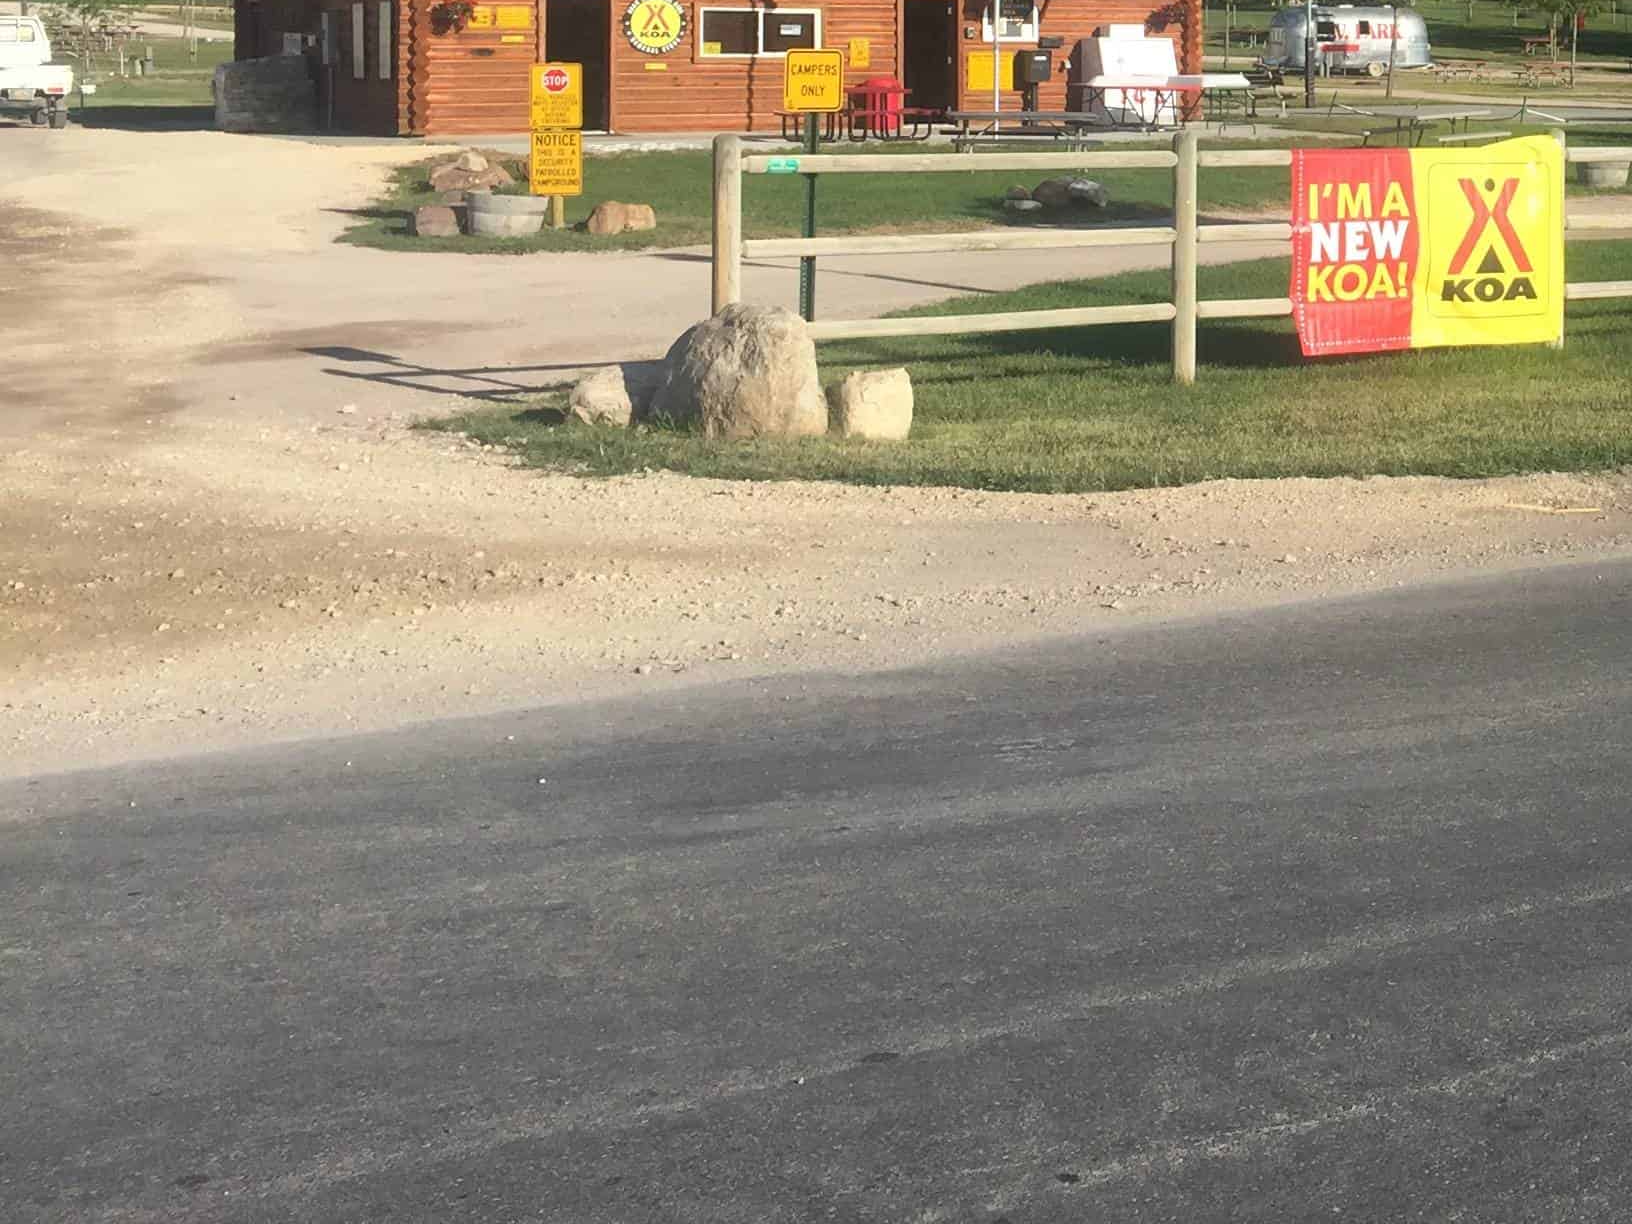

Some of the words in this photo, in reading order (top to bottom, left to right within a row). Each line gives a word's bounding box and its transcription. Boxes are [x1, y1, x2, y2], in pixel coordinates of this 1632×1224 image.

[790, 63, 837, 76] CAMPERS
[543, 75, 568, 86] STOP
[801, 84, 825, 96] ONLY
[535, 134, 576, 146] NOTICE
[1308, 181, 1372, 219] I'M
[1381, 181, 1410, 217] A
[1310, 219, 1410, 263] NEW
[1306, 261, 1409, 304] KOA!
[1440, 276, 1538, 303] KOA
